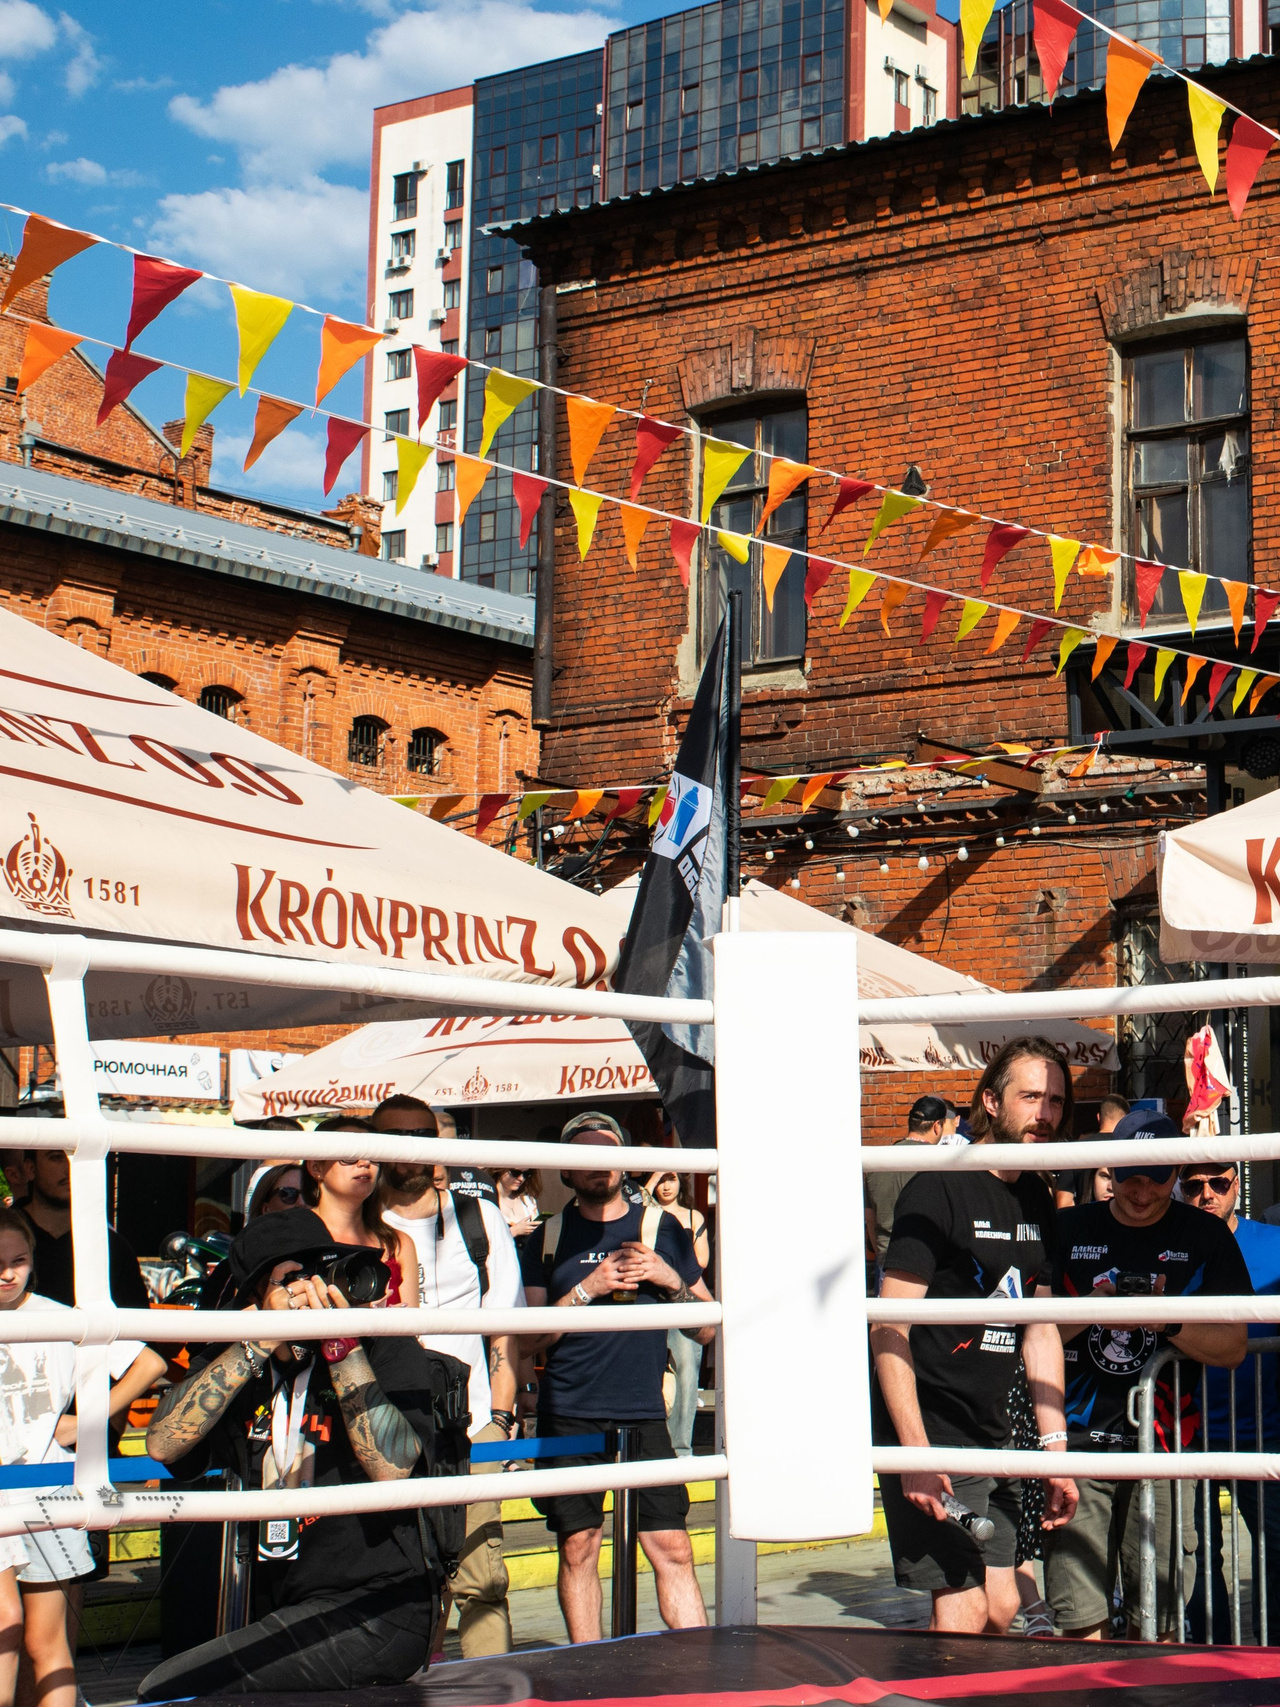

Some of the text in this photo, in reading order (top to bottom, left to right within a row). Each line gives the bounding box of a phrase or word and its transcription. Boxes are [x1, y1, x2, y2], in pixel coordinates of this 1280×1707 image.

[128, 734, 304, 805] 0.0
[83, 876, 141, 906] 1581
[230, 862, 556, 981] KRÓNPRINZ
[93, 1060, 188, 1078] РЮМОЧНАЯ
[495, 1083, 519, 1094] 1581
[1134, 1131, 1156, 1140] NIKE
[1071, 1244, 1109, 1254] АЛЕКСЕЙ
